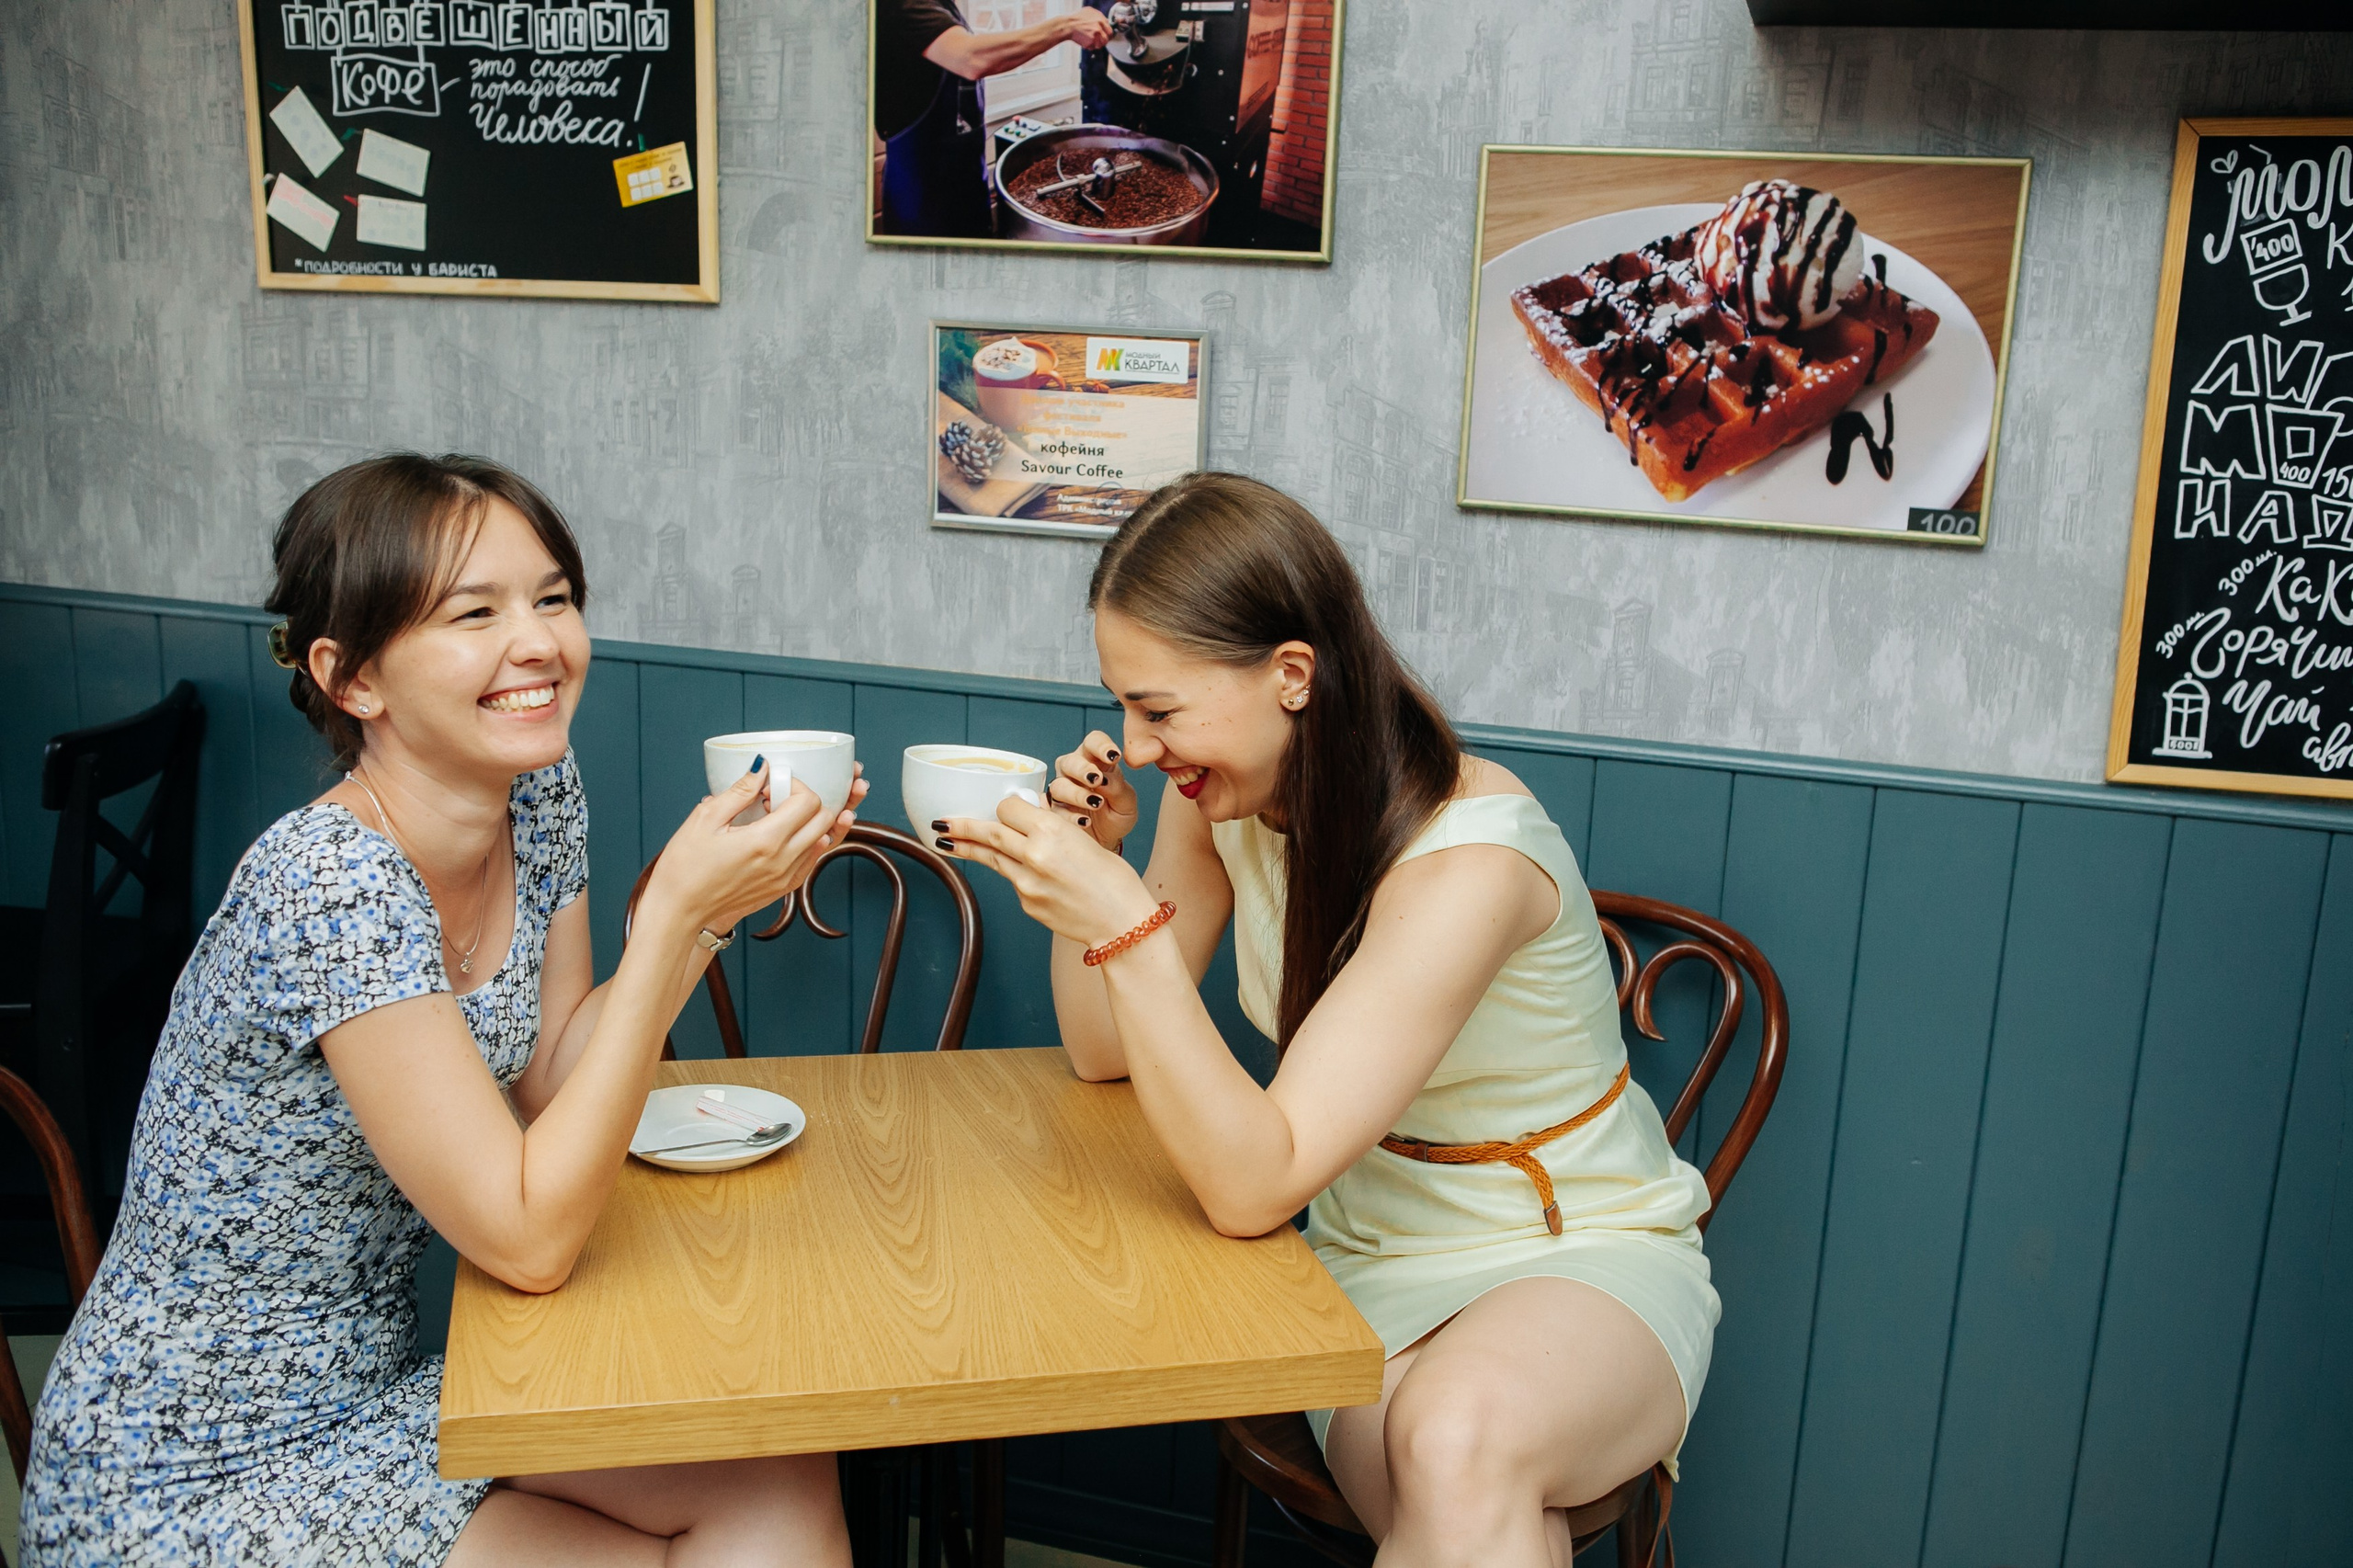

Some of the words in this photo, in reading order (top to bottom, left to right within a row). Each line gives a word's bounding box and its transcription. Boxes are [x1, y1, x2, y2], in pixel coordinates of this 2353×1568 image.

[285, 6, 666, 51] ПОДВЕШЕННЫЙ
[342, 61, 426, 108] Кофе
[469, 57, 517, 80] это
[529, 53, 623, 79] способ
[470, 75, 621, 114] порадовать
[428, 262, 499, 278] БАРИСТА
[1124, 358, 1181, 372] КВАРТАЛ
[1040, 441, 1105, 458] кофейня
[1021, 459, 1072, 476] Savour
[1076, 462, 1124, 479] Coffee
[2279, 461, 2312, 483] 400
[1920, 512, 1976, 535] 100
